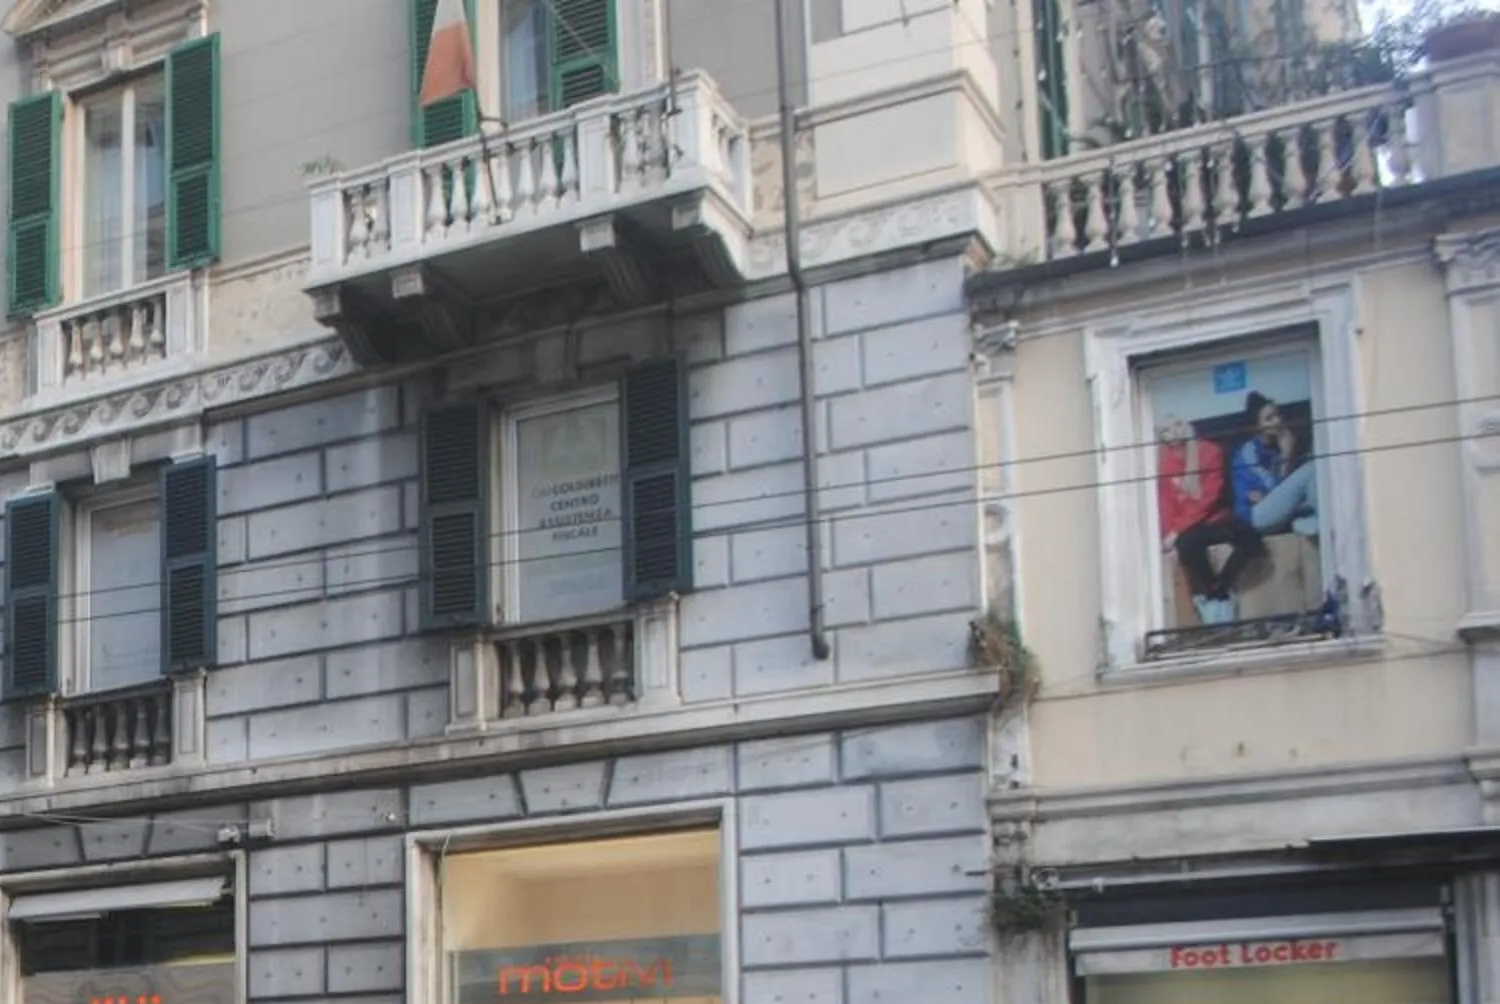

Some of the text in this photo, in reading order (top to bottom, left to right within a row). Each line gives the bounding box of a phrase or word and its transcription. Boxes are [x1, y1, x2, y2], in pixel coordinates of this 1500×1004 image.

[549, 493, 599, 512] CENTRO
[1170, 938, 1338, 969] Foot Locker
